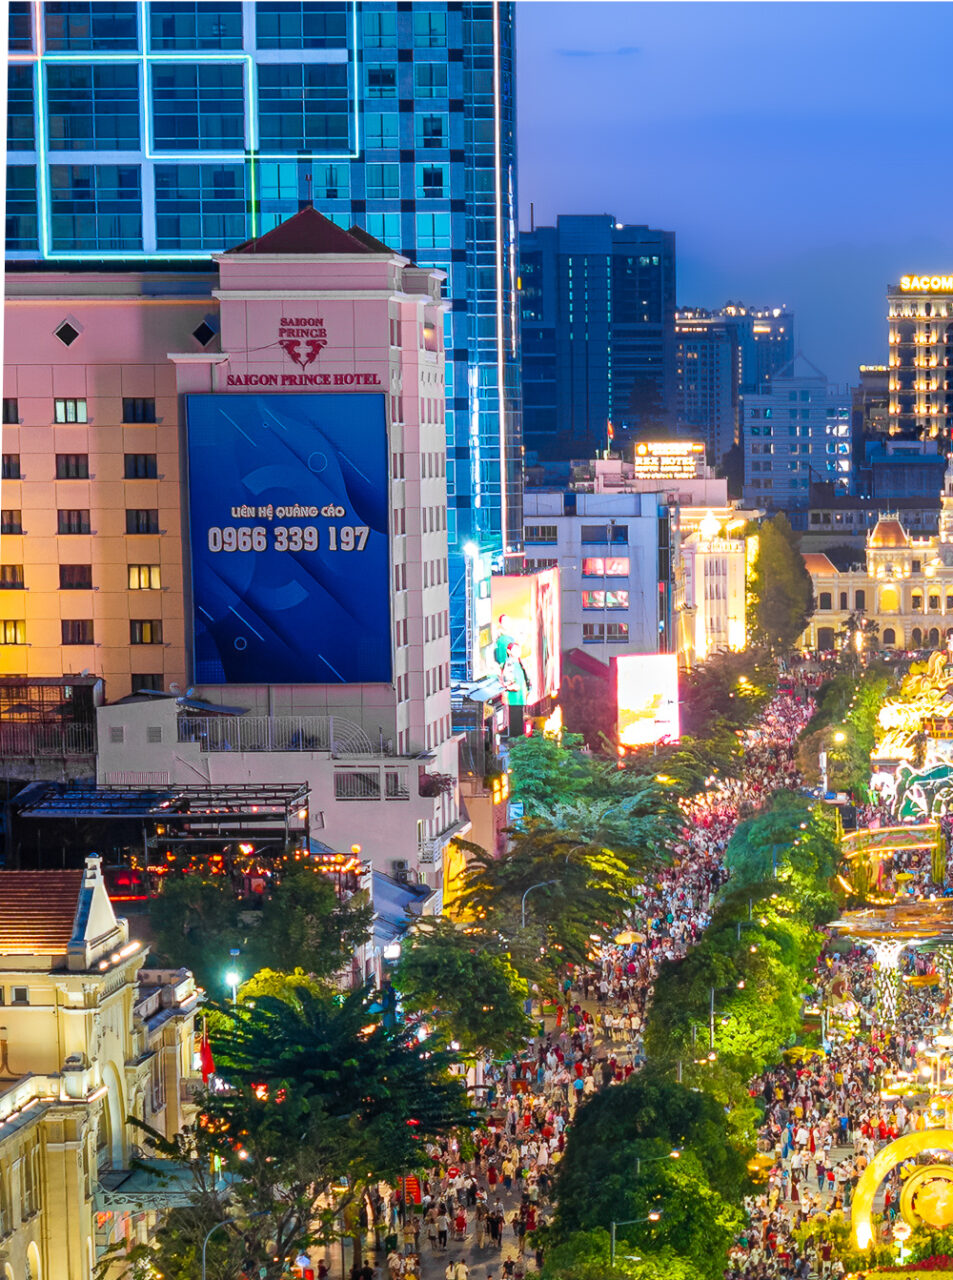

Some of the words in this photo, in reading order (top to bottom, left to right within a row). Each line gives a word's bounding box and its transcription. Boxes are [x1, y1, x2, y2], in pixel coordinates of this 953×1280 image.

[280, 317, 324, 327] SAIGON
[278, 327, 328, 338] PRINCE
[227, 373, 278, 386] SAIGON
[281, 373, 332, 386] PRINCE
[333, 373, 381, 386] HOTEL
[231, 504, 256, 518] LIÊN
[258, 503, 273, 521] HỆ
[321, 503, 346, 518] CÁO
[208, 526, 267, 552] 0966
[274, 526, 319, 552] 339
[328, 526, 370, 551] 197
